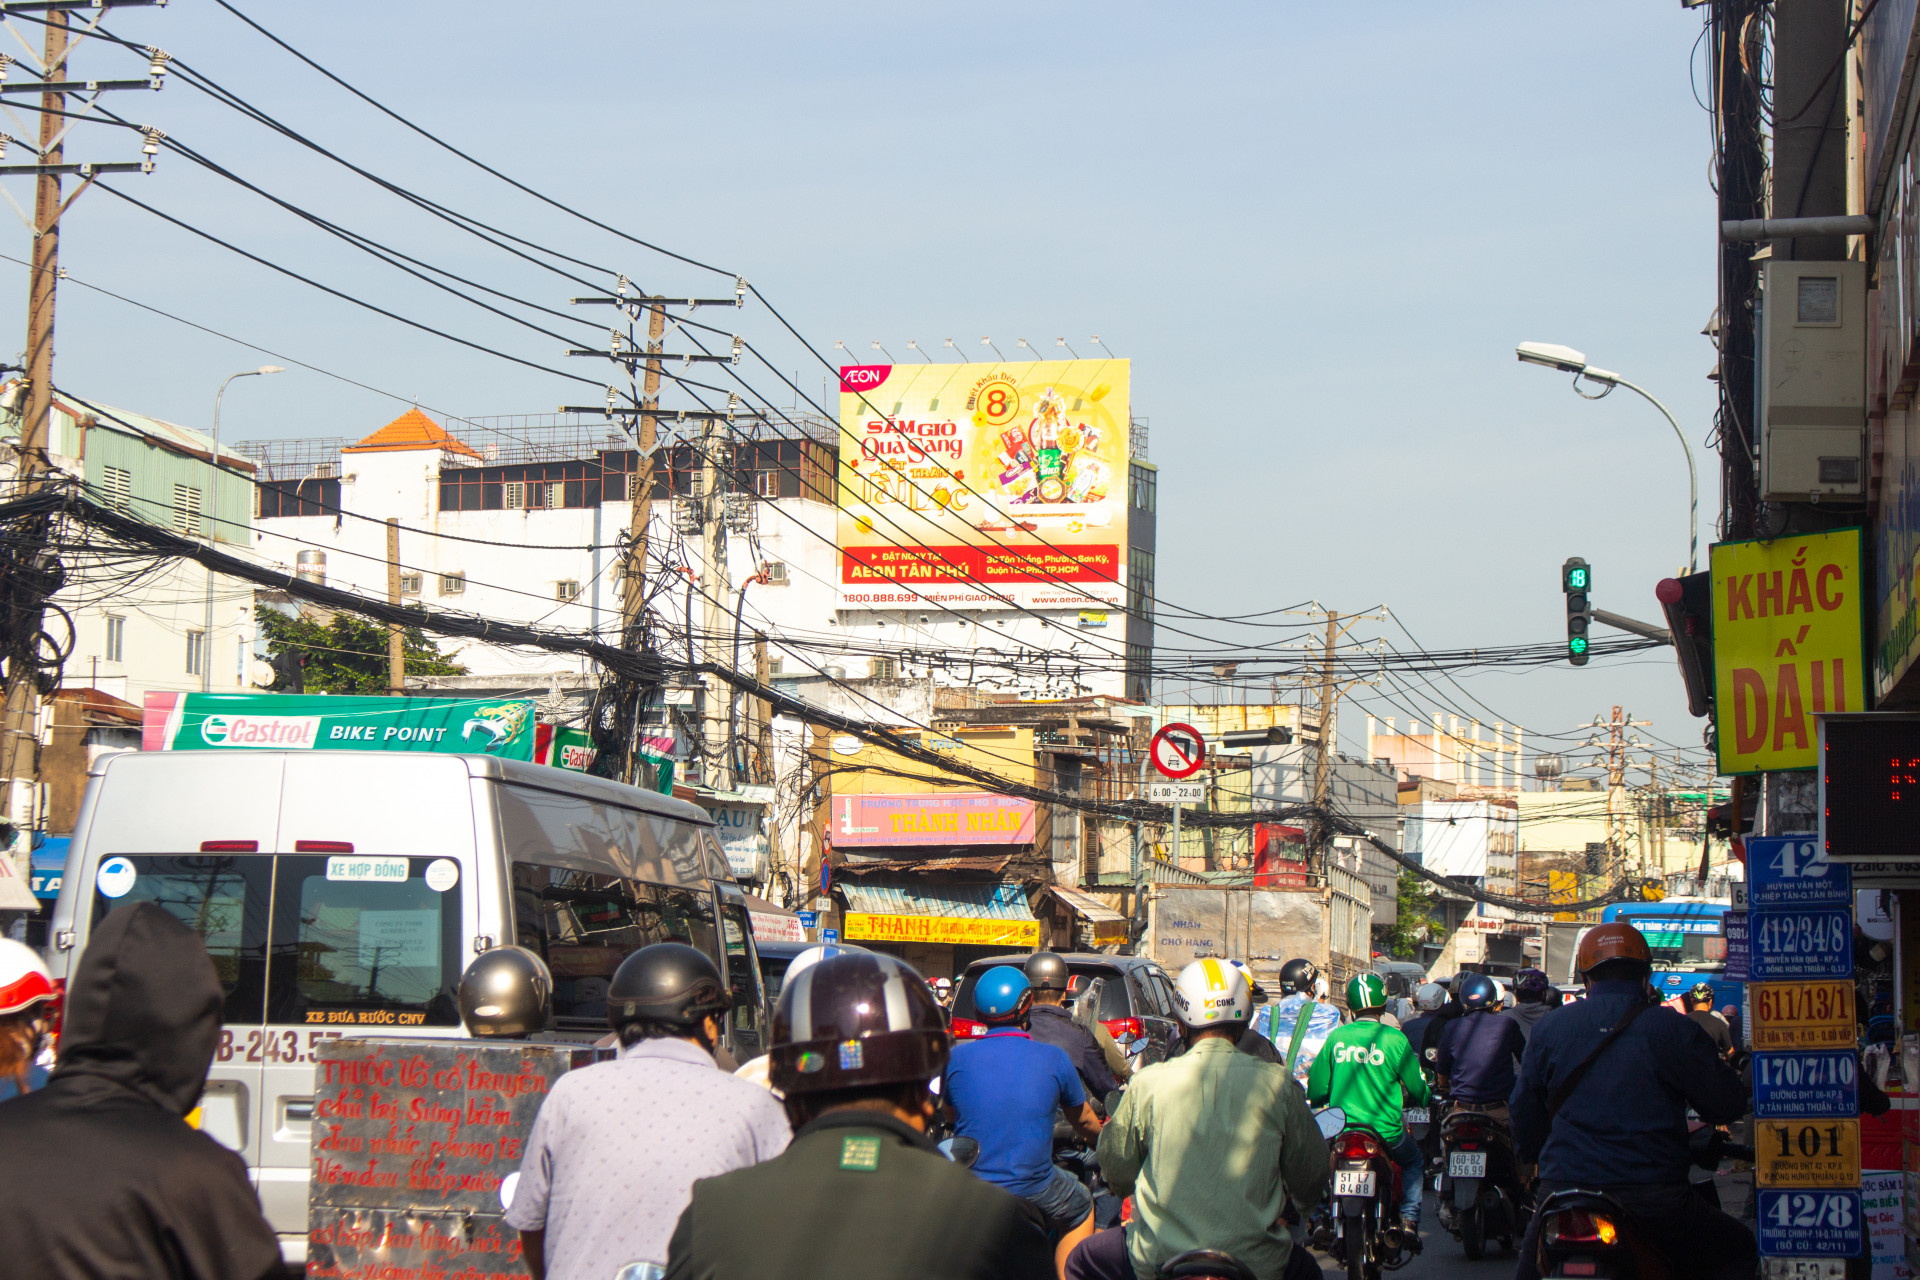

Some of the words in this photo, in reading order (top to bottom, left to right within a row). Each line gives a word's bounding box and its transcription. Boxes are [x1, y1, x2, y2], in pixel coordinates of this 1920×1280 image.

[907, 438, 963, 463] Sang
[851, 565, 896, 578] AEON
[899, 562, 932, 578] TÂN
[935, 562, 970, 578] PHÚ
[986, 566, 1008, 575] Quận
[1046, 566, 1079, 574] TP.HCM
[1727, 546, 1844, 622] KHẮC
[843, 594, 918, 602] 1800.888.699
[965, 594, 987, 602] GIAO
[230, 718, 311, 744] Castrol
[330, 726, 377, 740] BIKE
[384, 727, 447, 743] POINT
[889, 808, 959, 833] THÀNH
[967, 808, 1022, 832] NHÂN
[331, 864, 345, 876] XE
[1769, 842, 1830, 879] 42
[1767, 881, 1796, 891] HUỲNH
[1797, 880, 1814, 890] VĂN
[1816, 880, 1833, 890] MỘT
[1758, 914, 1844, 953] 412/34/8
[1216, 998, 1236, 1008] CONS
[1759, 986, 1849, 1022] 611/13/1
[306, 1012, 325, 1023] XE
[398, 1013, 426, 1025] CNV
[216, 1030, 343, 1063] B-243.5
[1334, 1042, 1385, 1066] Grab
[1760, 1057, 1854, 1087] 170/7/10
[1770, 1089, 1797, 1100] ĐƯỜNG
[1783, 1102, 1805, 1112] HƯNG
[1776, 1126, 1843, 1157] 101
[1340, 1184, 1369, 1194] 8488
[1768, 1194, 1853, 1228] 42/8
